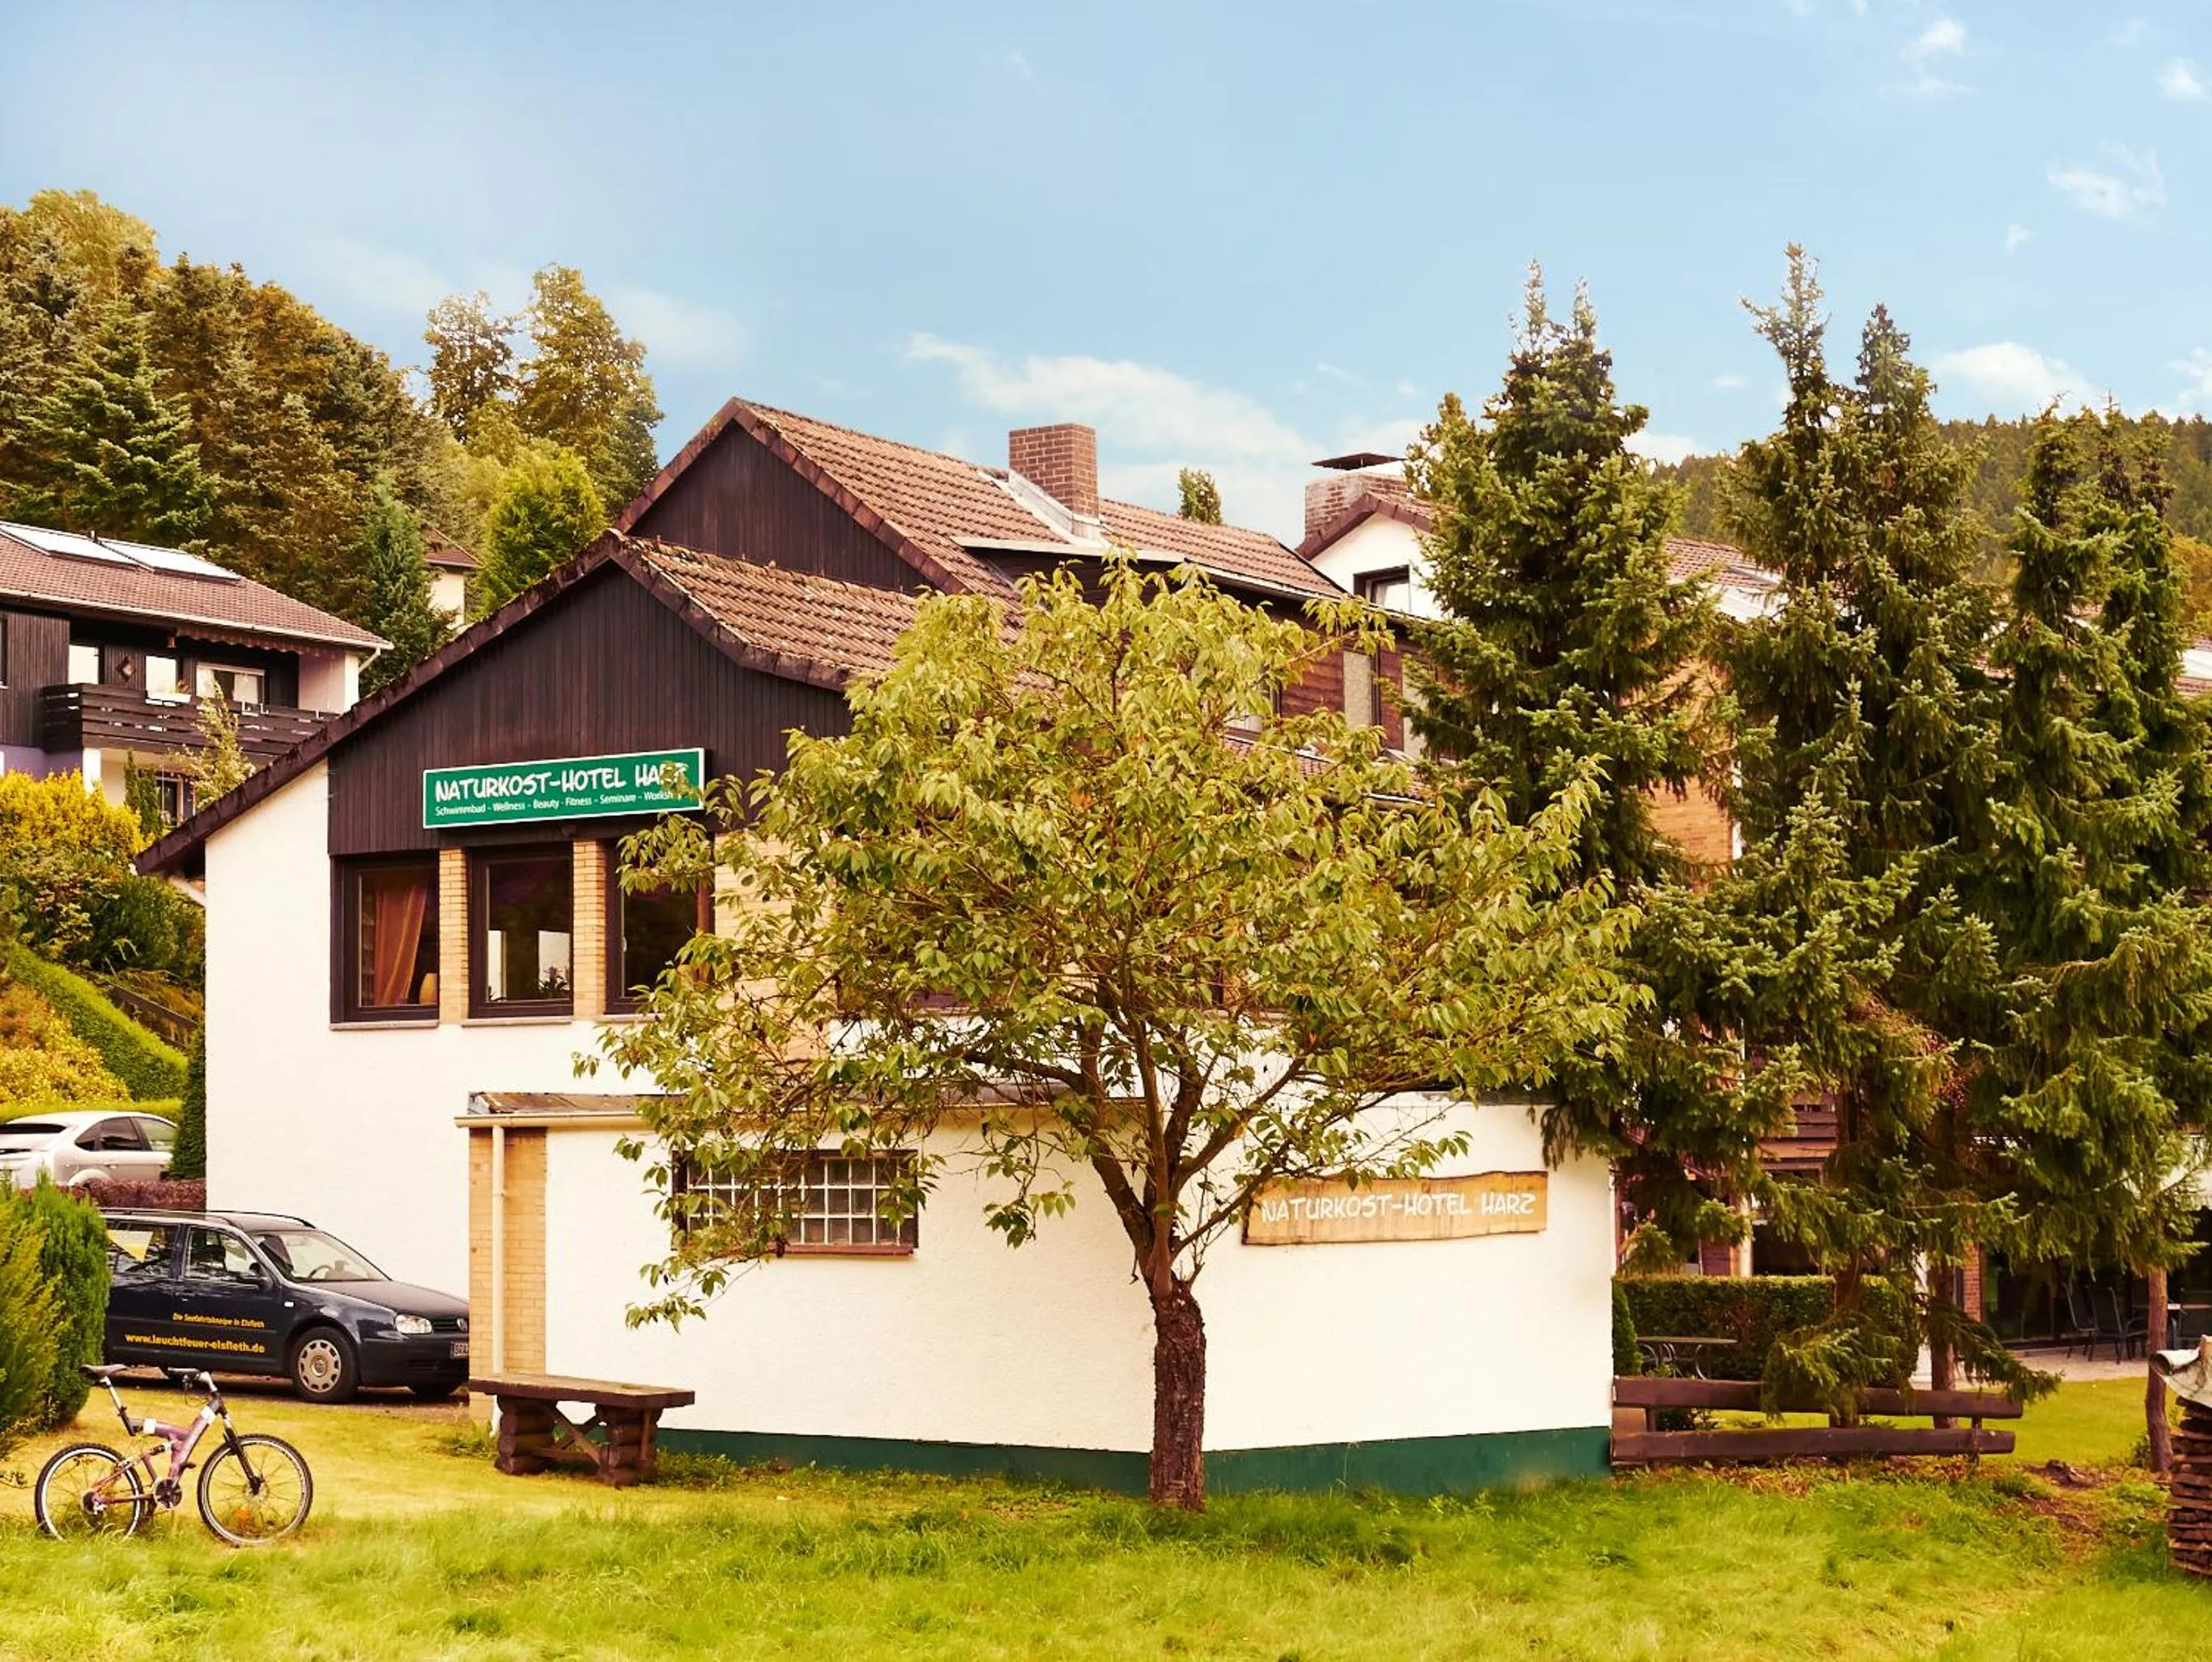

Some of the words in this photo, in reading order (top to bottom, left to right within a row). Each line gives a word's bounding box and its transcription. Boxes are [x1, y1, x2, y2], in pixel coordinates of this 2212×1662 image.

[435, 767, 627, 802] NATURKOST-HOTEL
[436, 803, 486, 816] Schwimmbad
[492, 801, 525, 812] Wellness
[533, 798, 559, 810] Beauty
[565, 797, 592, 806] Fitness
[599, 793, 636, 805] Seminare
[1261, 1193, 1472, 1222] NATURKOST-HOTEL
[1481, 1191, 1536, 1215] HARZ
[125, 1334, 265, 1354] www.leuchtfeuer-elsfleth.de
